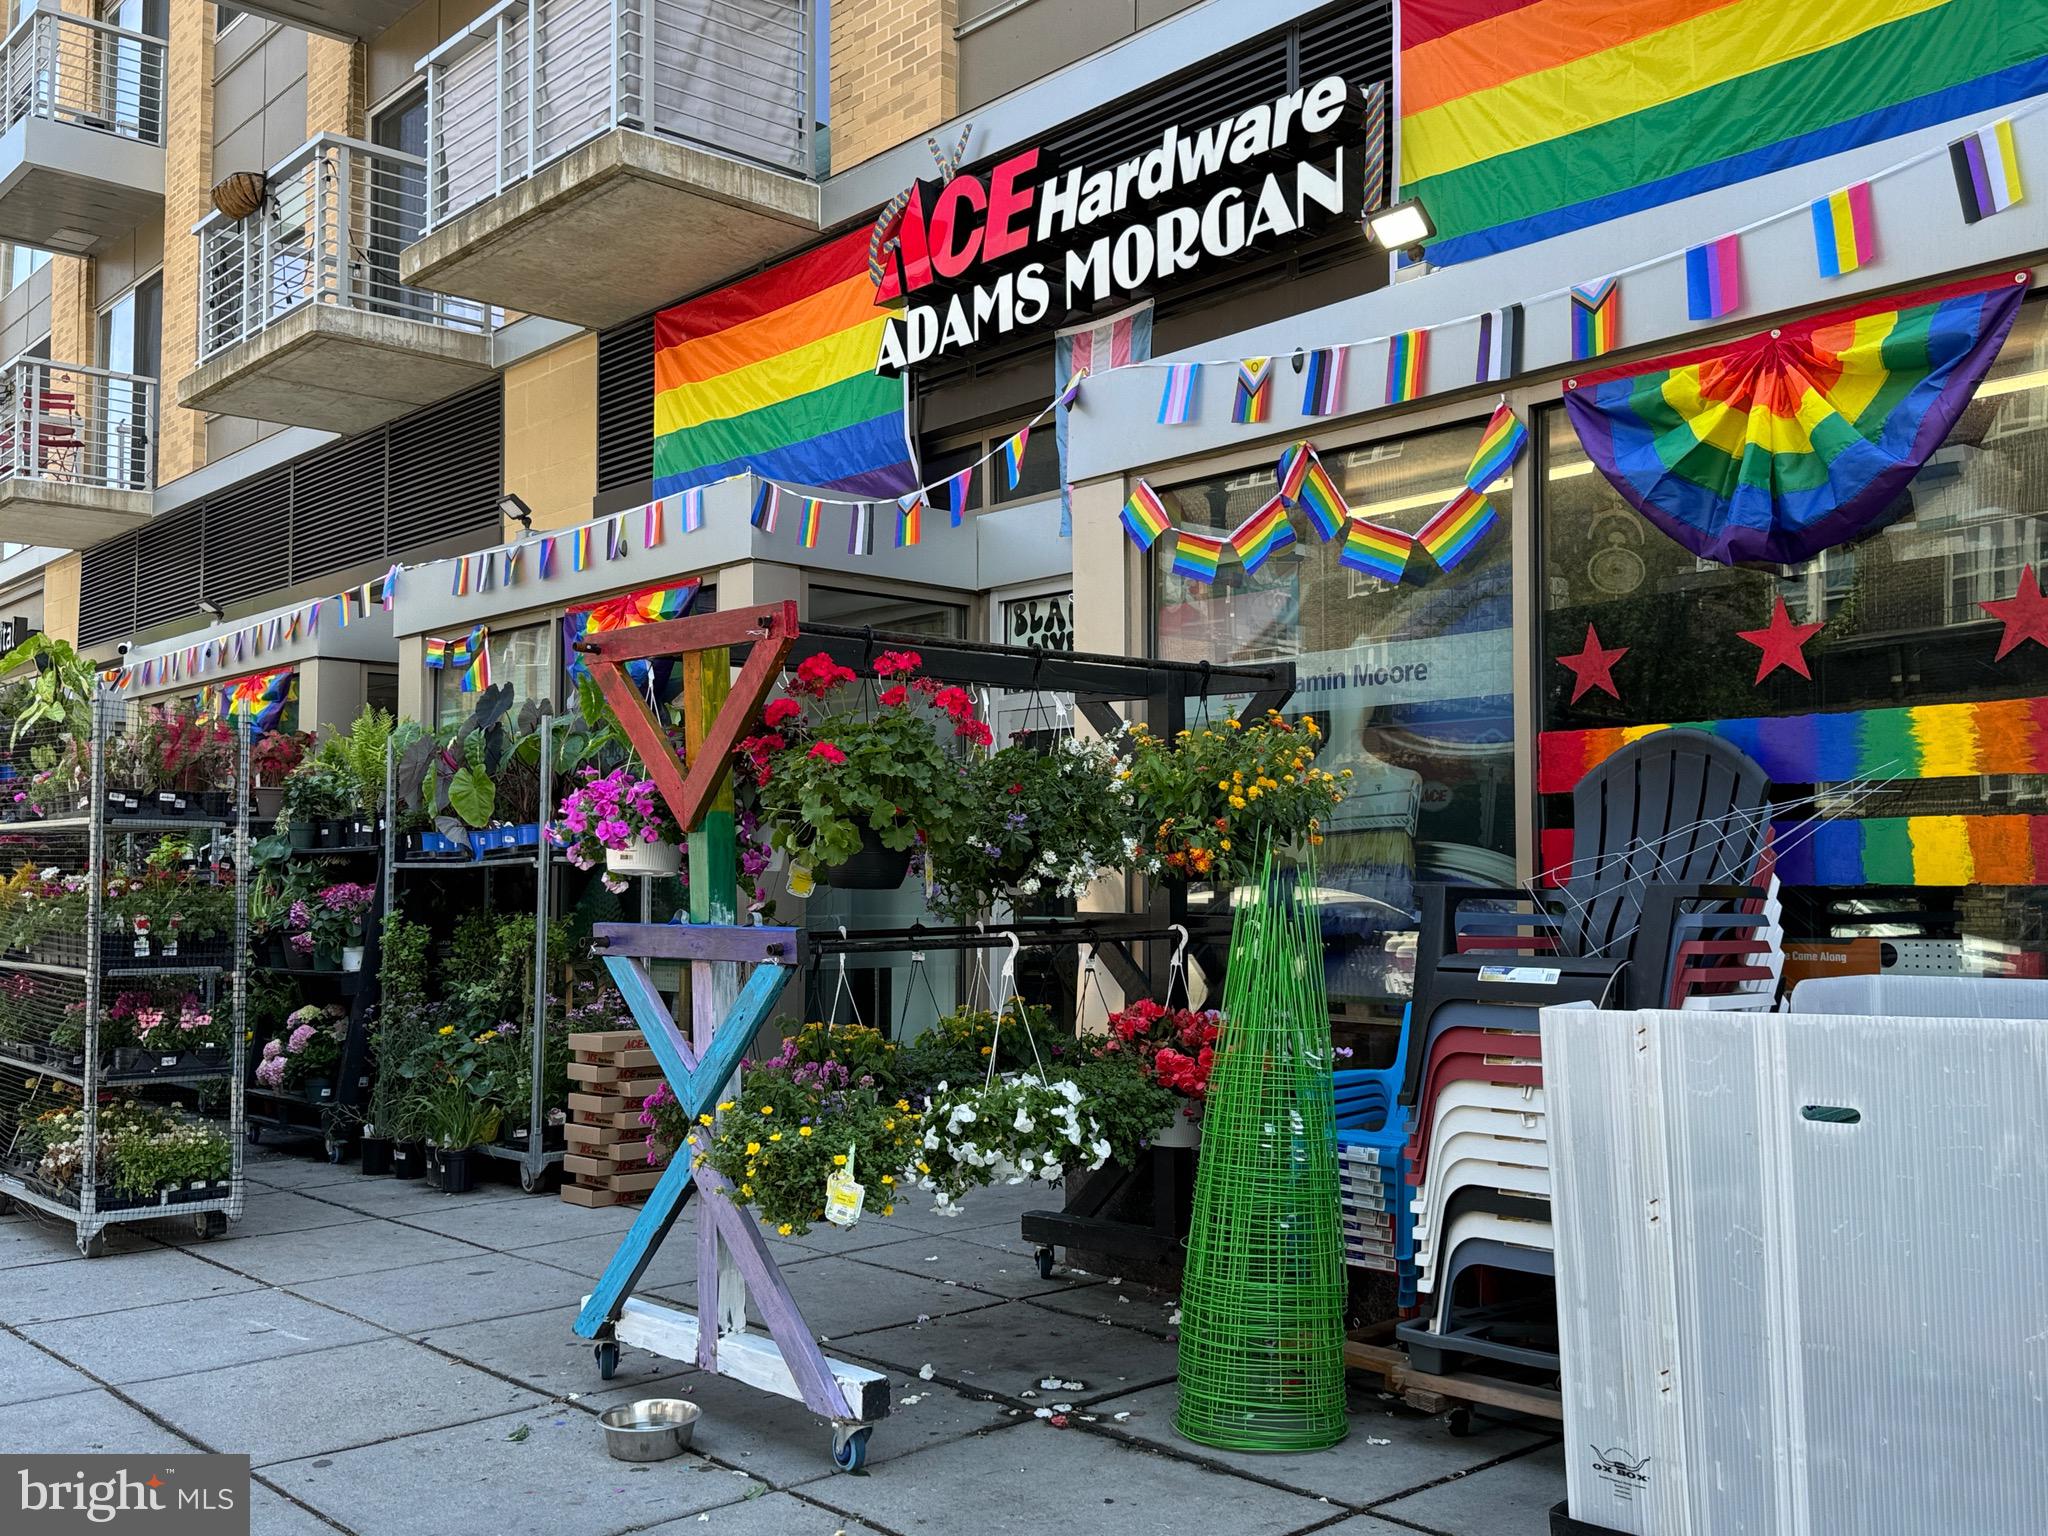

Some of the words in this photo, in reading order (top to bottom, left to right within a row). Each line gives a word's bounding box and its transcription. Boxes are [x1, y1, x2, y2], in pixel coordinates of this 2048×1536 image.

[874, 147, 1042, 306] ACE
[1036, 75, 1348, 242] Hardware
[875, 263, 1050, 375] ADAMS
[1066, 147, 1344, 310] MORGAN
[1013, 598, 1073, 637] BLA
[1295, 666, 1346, 693] amin
[1352, 662, 1428, 688] Moore
[1792, 951, 1818, 961] Come
[1820, 952, 1847, 964] Along
[624, 1038, 645, 1050] ACE
[616, 1068, 636, 1080] ACE
[1592, 1462, 1613, 1474] OX
[1616, 1468, 1648, 1482] BOX
